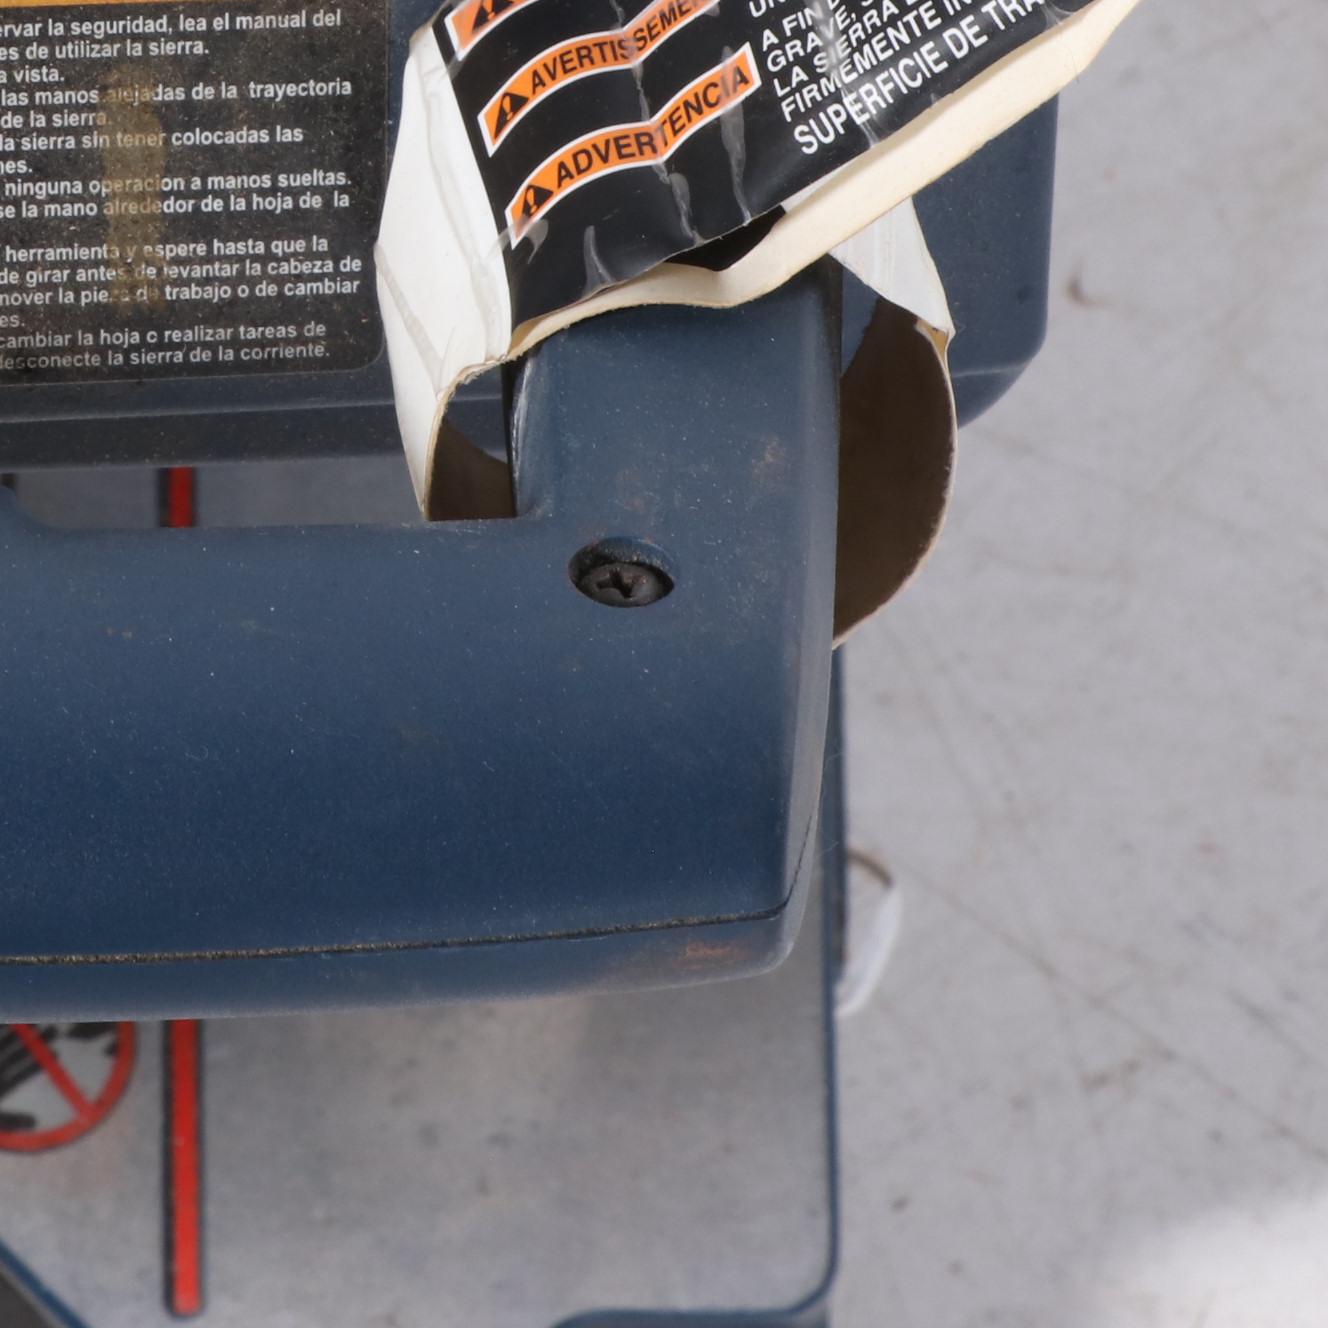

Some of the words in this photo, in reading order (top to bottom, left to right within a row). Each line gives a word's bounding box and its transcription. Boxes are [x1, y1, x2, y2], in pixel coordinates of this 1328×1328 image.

[47, 18, 64, 36] la
[70, 15, 172, 39] seguridad,
[179, 13, 206, 32] lea
[212, 13, 229, 31] el
[235, 10, 306, 30] manual
[312, 9, 341, 27] del
[25, 42, 48, 60] de
[54, 40, 121, 59] utilizar
[125, 39, 142, 57] la
[148, 37, 209, 56] sierra.
[13, 64, 64, 83] vista.
[793, 41, 948, 154] SUPERFICIE
[943, 15, 989, 59] DE
[556, 65, 750, 192] ADVERTENCIA
